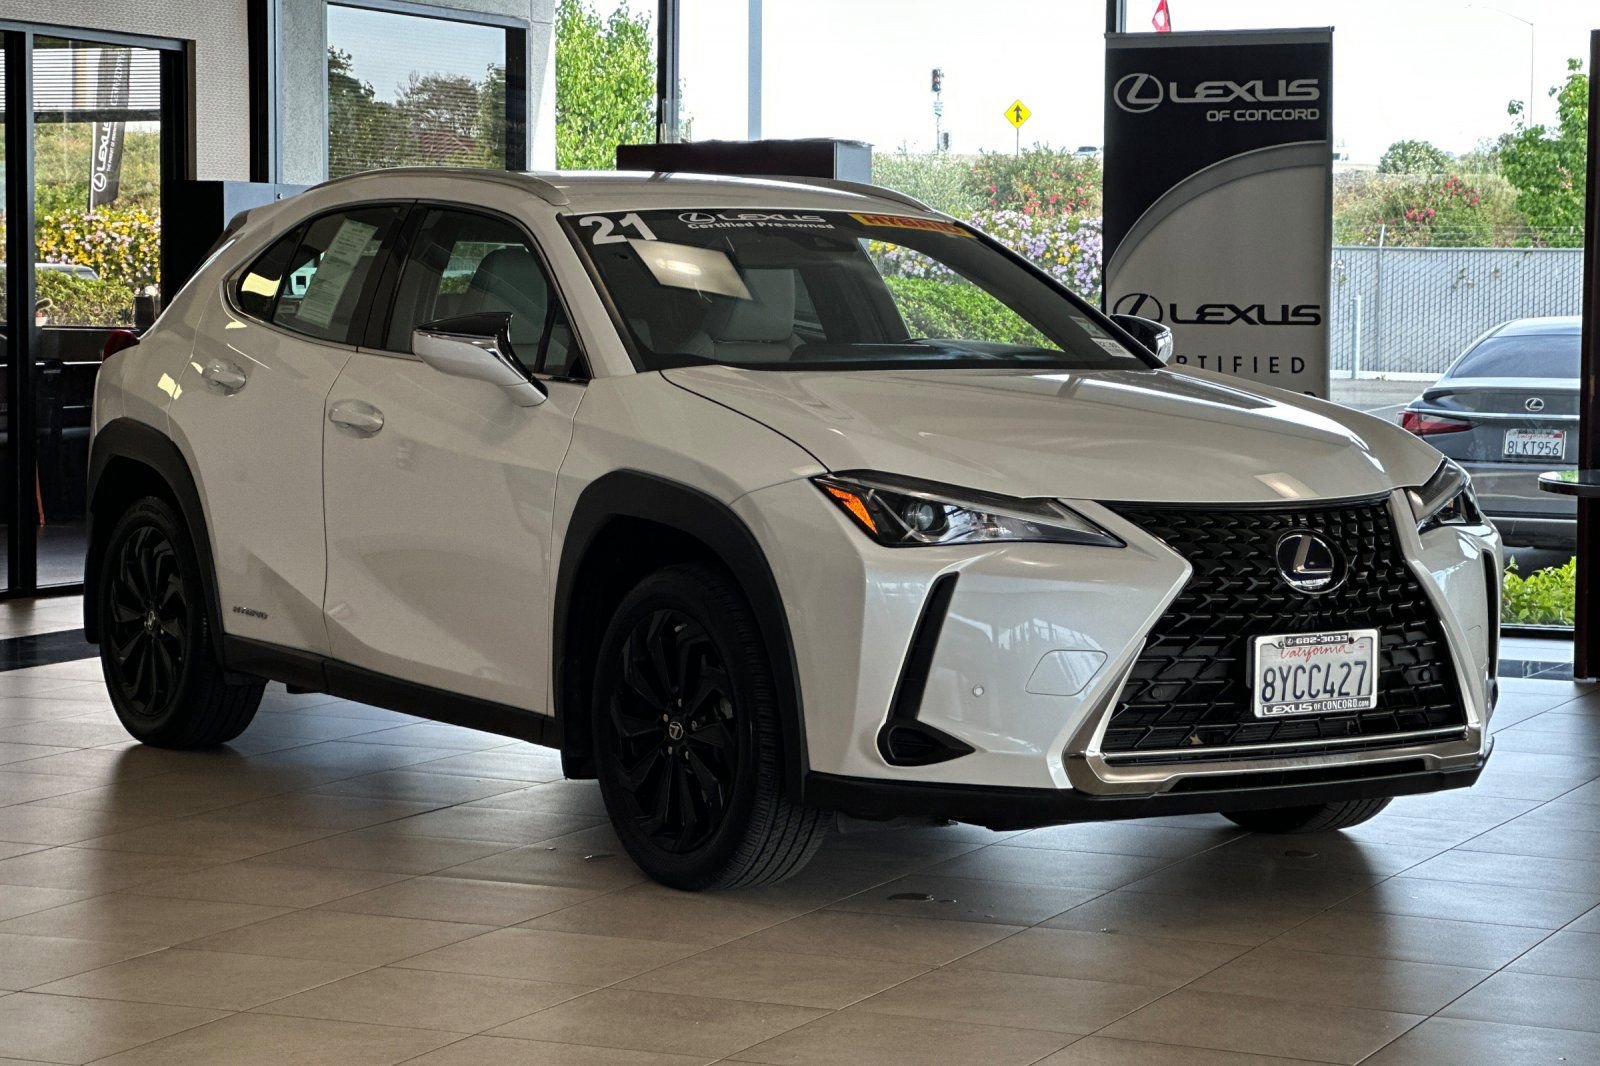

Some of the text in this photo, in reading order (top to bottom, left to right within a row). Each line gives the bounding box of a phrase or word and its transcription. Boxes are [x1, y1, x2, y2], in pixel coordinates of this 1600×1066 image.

[1169, 79, 1320, 103] LEXUS
[1206, 108, 1320, 122] OF CONCORD
[717, 213, 826, 222] LEXUS
[756, 221, 835, 229] Pre-owned
[579, 213, 658, 245] 21
[1170, 303, 1321, 326] LEXUS
[1176, 355, 1305, 374] RTIFIED
[1508, 441, 1560, 455] 8LKT956
[1280, 643, 1352, 662] California
[1261, 660, 1367, 702] 8YCC427
[1263, 702, 1313, 715] LEXUS
